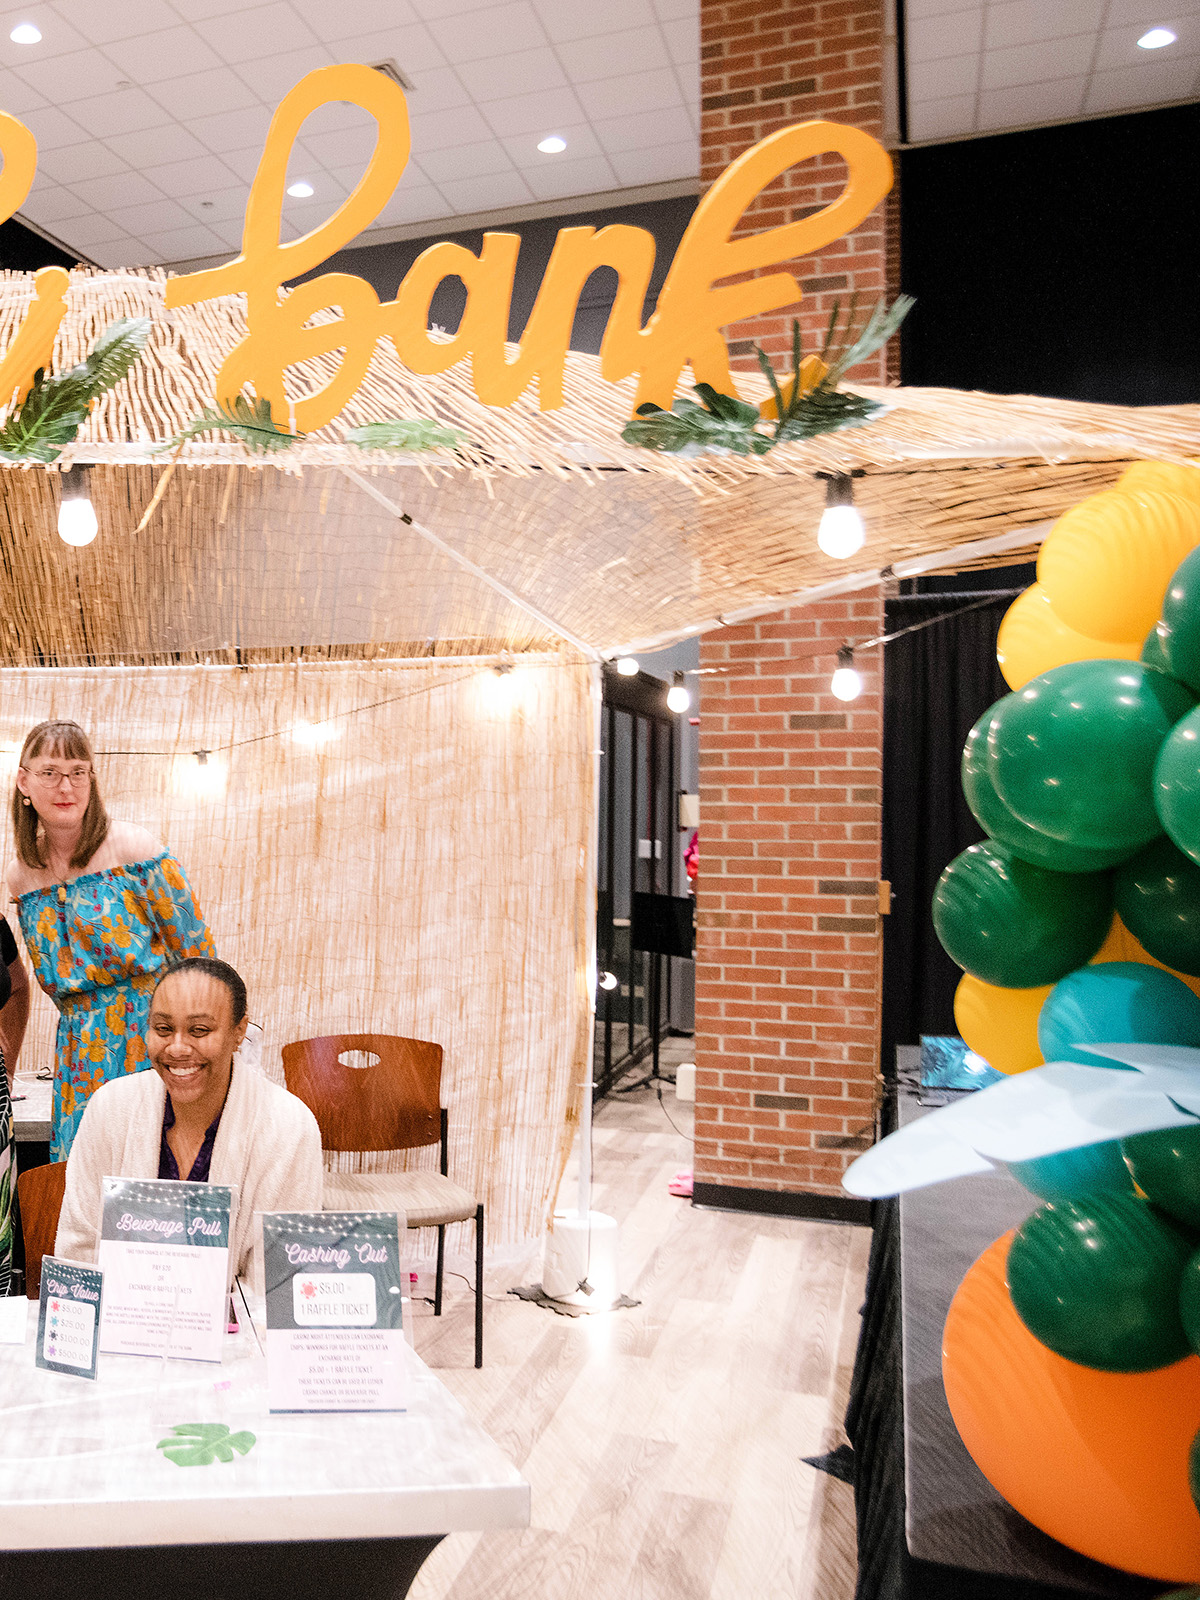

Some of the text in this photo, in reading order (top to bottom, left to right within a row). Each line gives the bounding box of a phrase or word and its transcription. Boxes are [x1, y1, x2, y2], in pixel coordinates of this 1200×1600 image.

[167, 63, 893, 432] bank
[116, 1214, 222, 1238] Beverage Pull
[285, 1243, 388, 1269] Cashing Out
[47, 1279, 99, 1301] Chip Value
[319, 1282, 344, 1294] $5.00
[62, 1305, 82, 1314] $5.00
[308, 1304, 338, 1315] RAFFLE
[342, 1304, 369, 1315] TICKET
[61, 1320, 85, 1330] $25.00
[60, 1334, 90, 1346] $100.00
